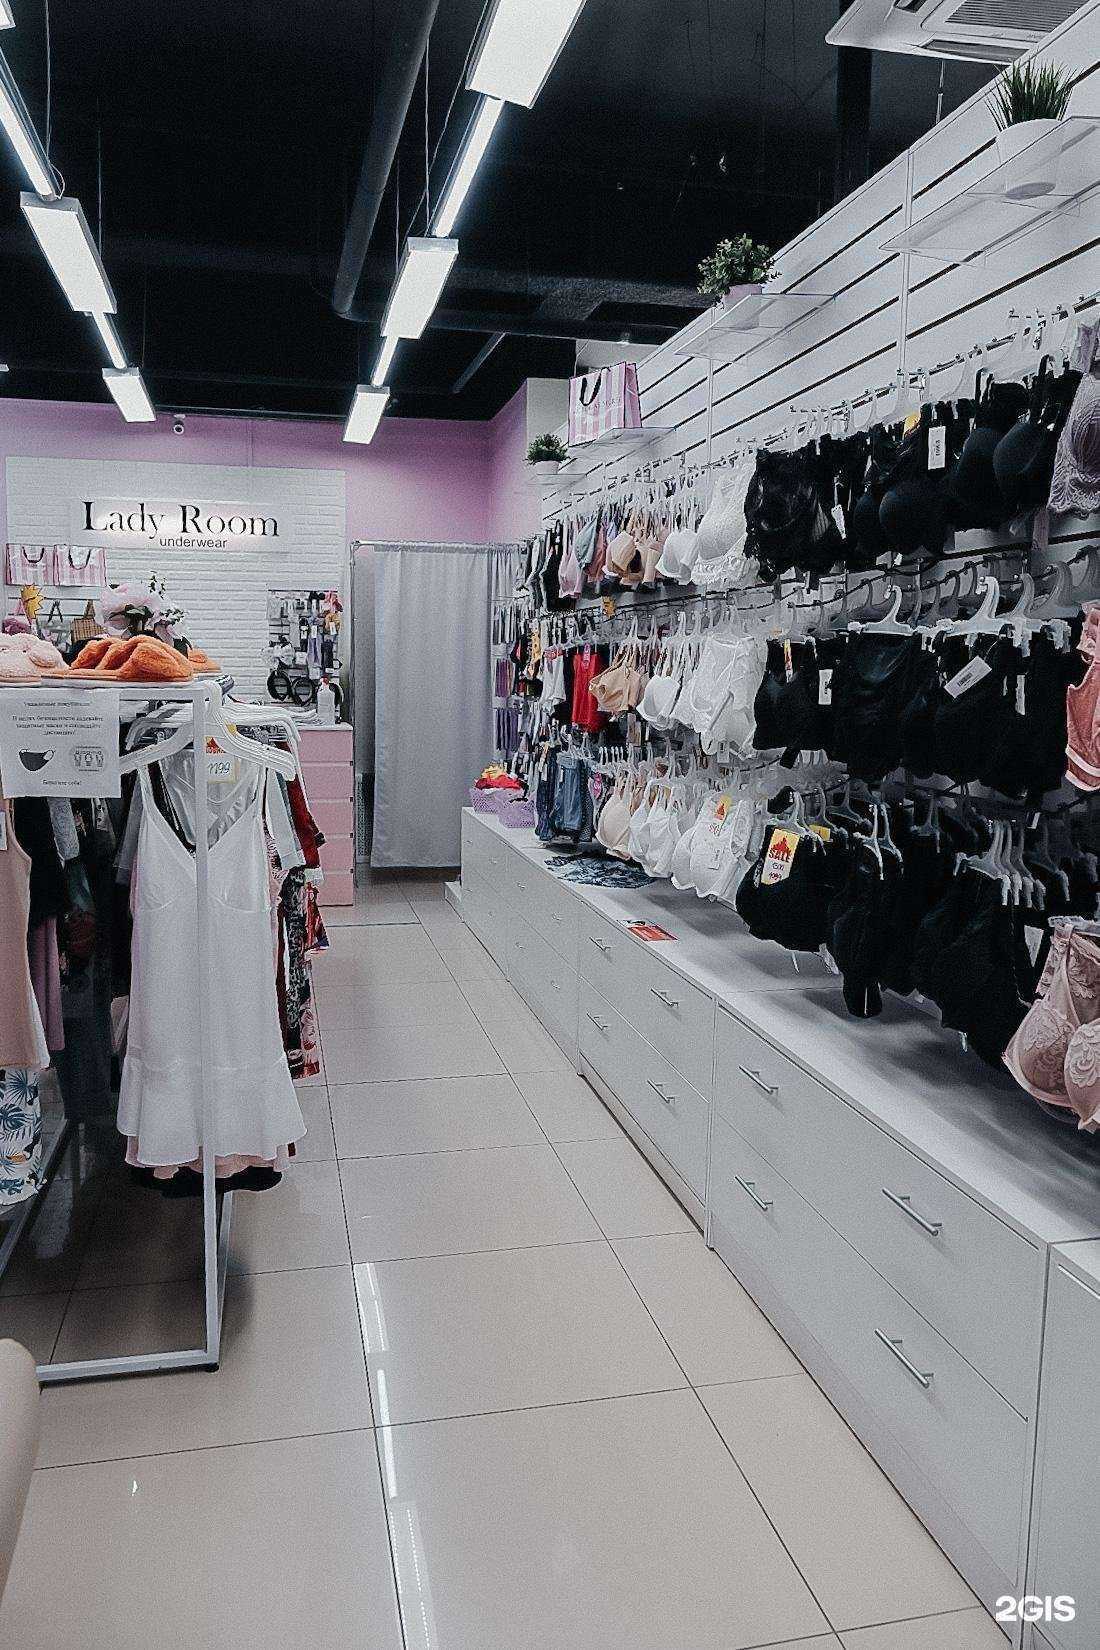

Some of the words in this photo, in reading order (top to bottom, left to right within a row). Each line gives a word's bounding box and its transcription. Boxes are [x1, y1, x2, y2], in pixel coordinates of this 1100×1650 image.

[82, 501, 166, 539] Lady
[179, 505, 280, 537] Room
[159, 537, 228, 549] underwear
[769, 847, 792, 863] SALE
